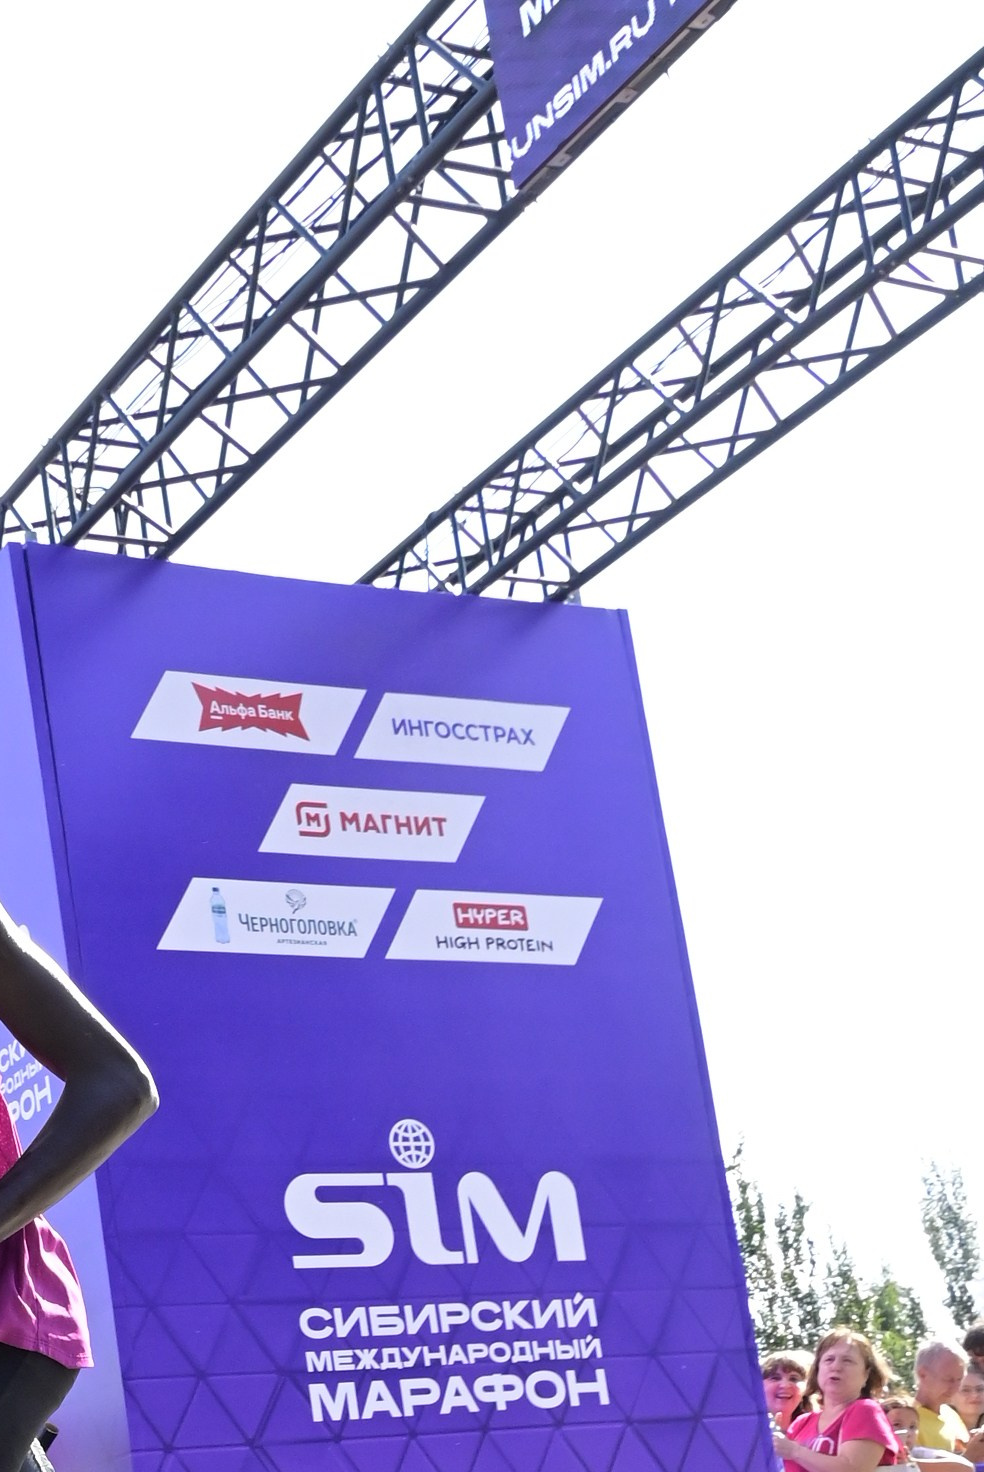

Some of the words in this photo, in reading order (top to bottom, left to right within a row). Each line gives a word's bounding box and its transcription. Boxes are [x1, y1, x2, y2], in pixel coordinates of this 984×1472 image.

[509, 0, 656, 165] UNSIM.RU
[209, 700, 256, 720] Альфа
[257, 704, 294, 721] Банк
[391, 717, 536, 746] ИНГОССТРАХ
[339, 811, 447, 837] МАГНИТ
[456, 907, 525, 926] HYPER
[436, 935, 480, 950] HIGH
[485, 937, 554, 952] PROTEIN
[299, 1291, 598, 1339] СИБИРСКИЙ
[305, 1333, 603, 1373] МЕЖДУНАРОДНЫЙ
[308, 1368, 610, 1422] МАРАФОН
